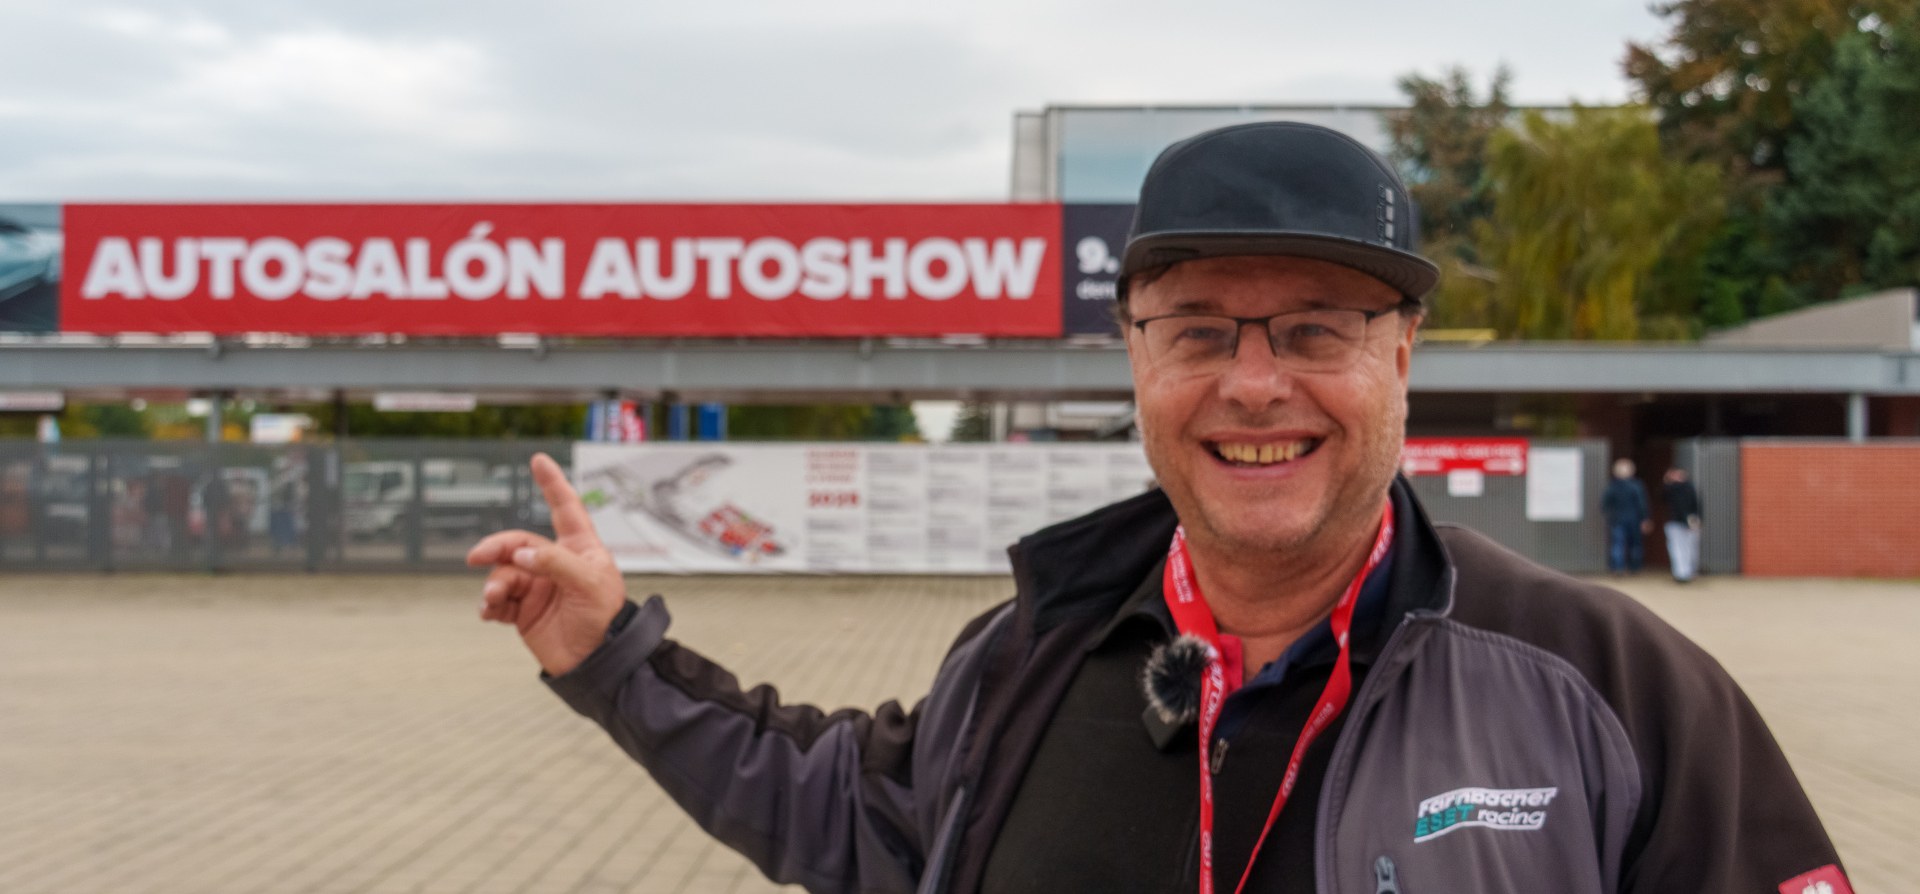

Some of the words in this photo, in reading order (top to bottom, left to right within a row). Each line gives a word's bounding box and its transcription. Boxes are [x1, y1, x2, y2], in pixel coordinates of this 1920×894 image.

[83, 222, 564, 300] AUTOSALÓN
[579, 237, 1046, 300] AUTOSHOW
[1076, 236, 1120, 274] 9.
[1415, 804, 1474, 837] ESET
[1477, 807, 1546, 826] racing
